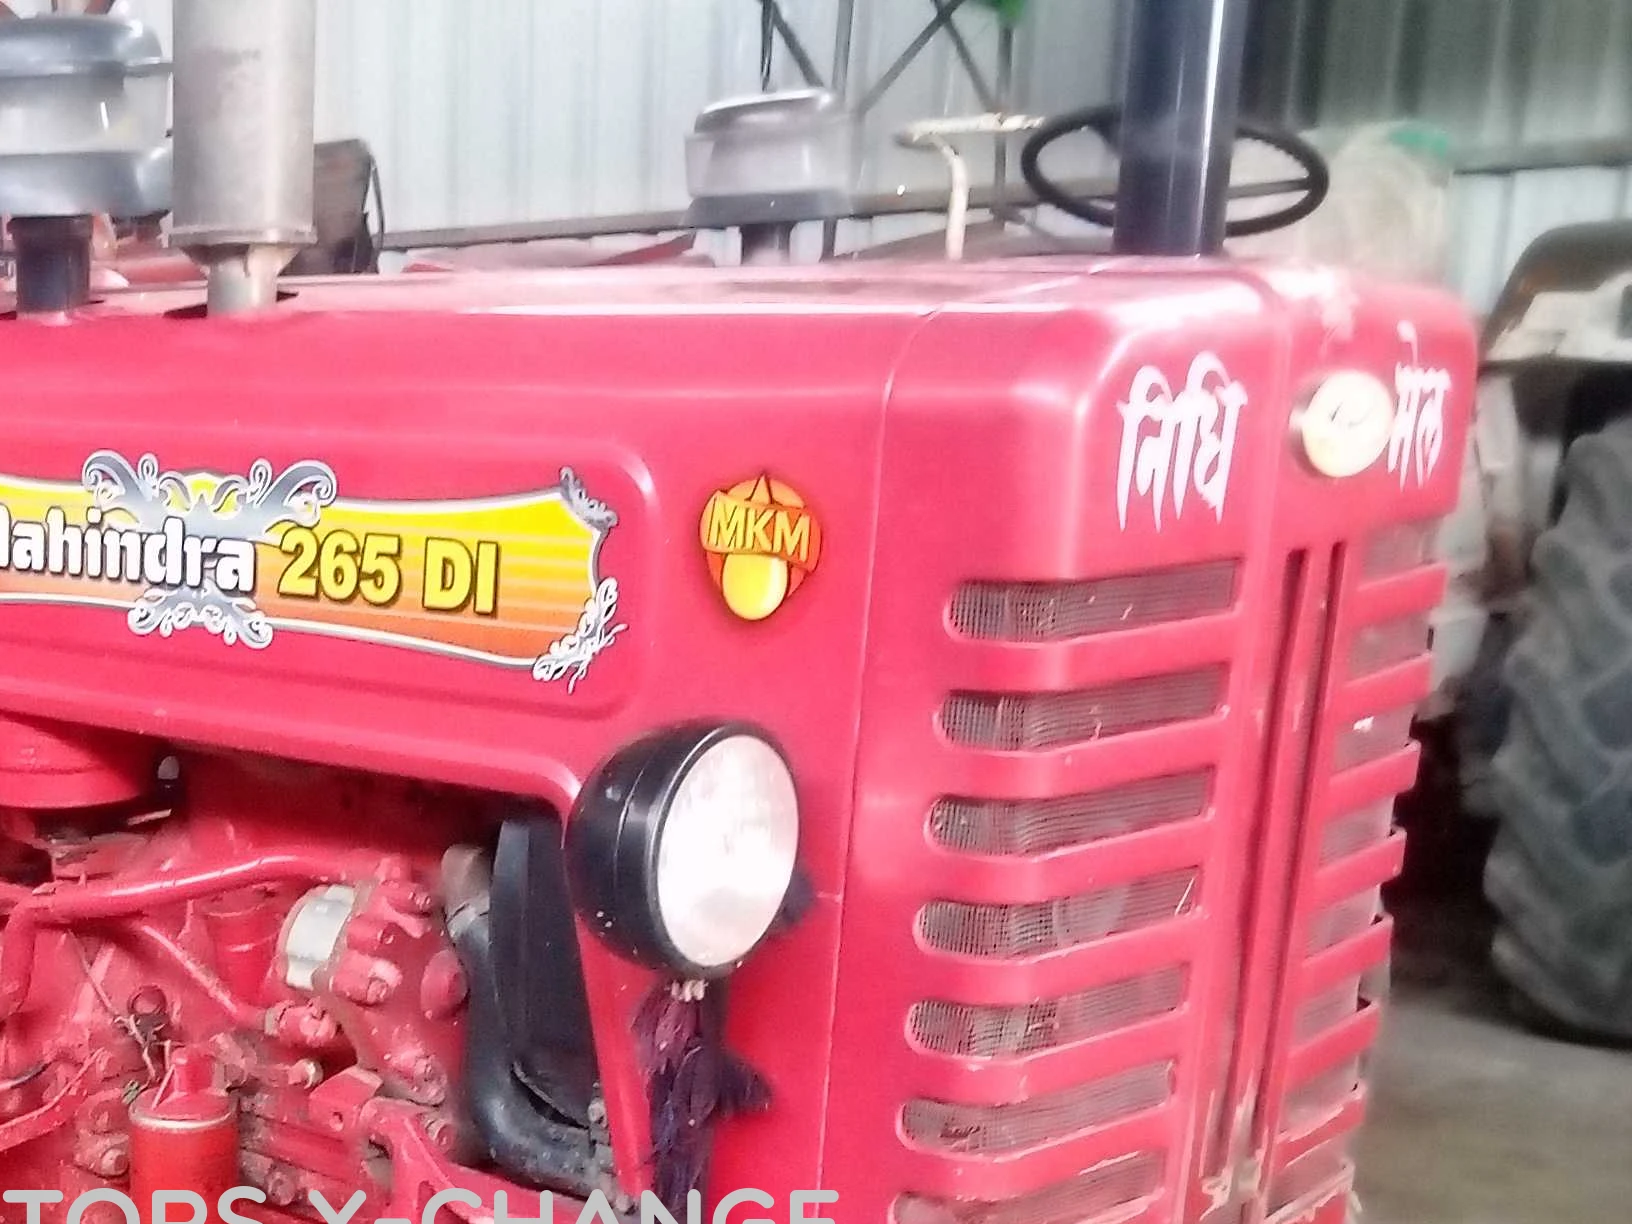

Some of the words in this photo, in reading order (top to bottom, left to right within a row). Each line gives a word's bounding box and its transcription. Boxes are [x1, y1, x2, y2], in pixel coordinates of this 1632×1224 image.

[707, 498, 811, 564] MKM
[278, 527, 402, 606] 265
[422, 536, 500, 616] DI
